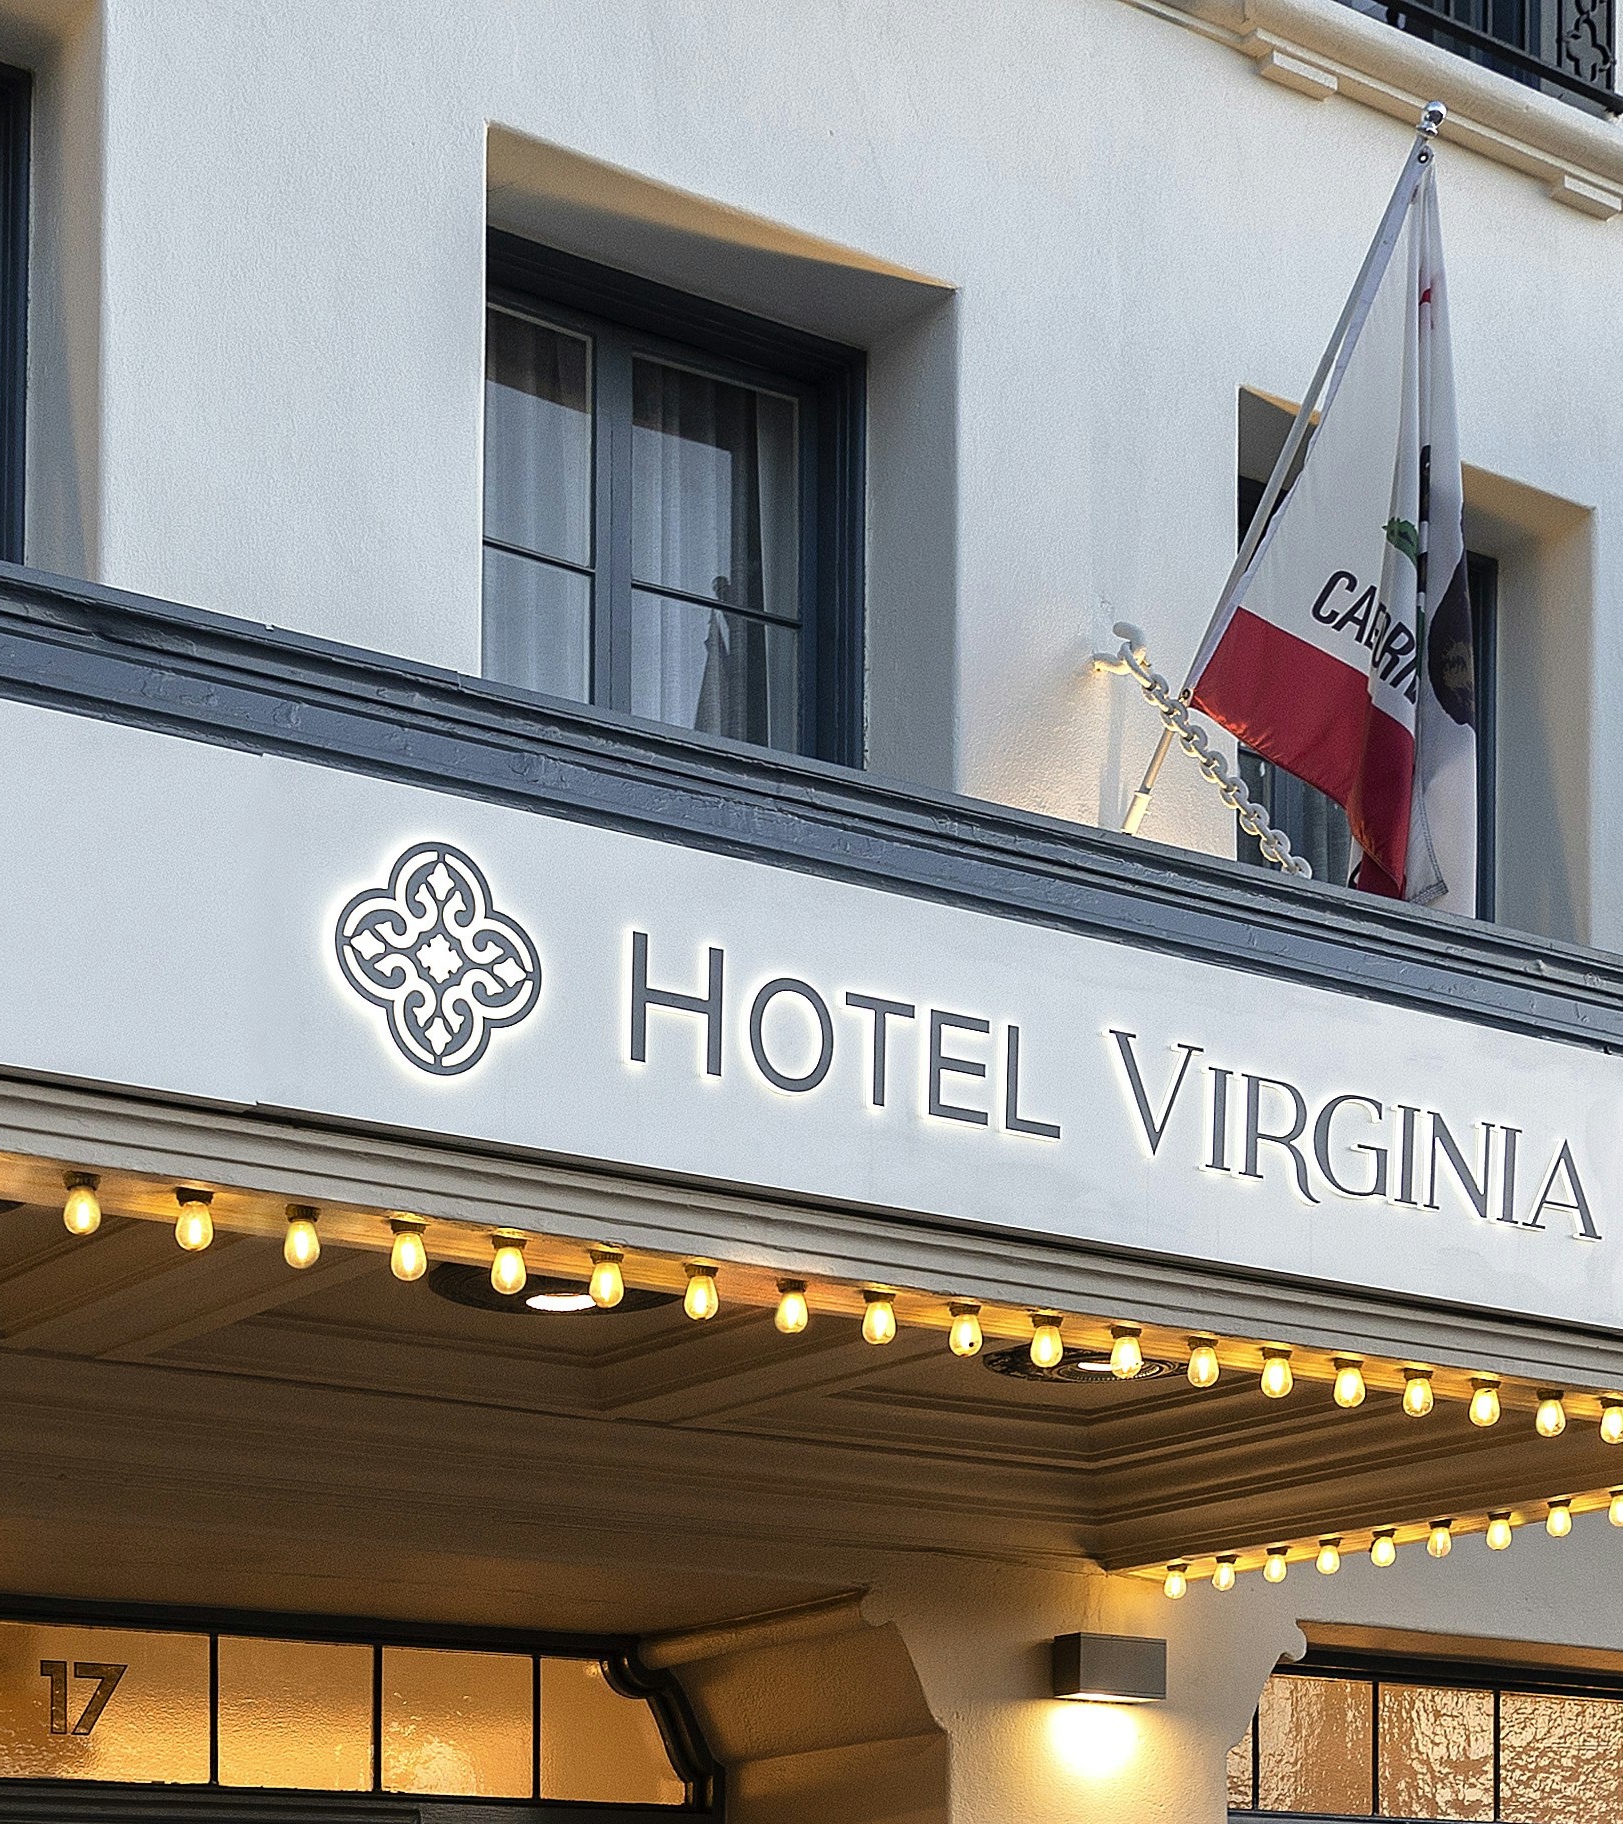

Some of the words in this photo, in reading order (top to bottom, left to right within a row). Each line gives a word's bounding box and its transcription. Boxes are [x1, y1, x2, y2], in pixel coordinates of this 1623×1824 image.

[629, 930, 1062, 1140] HOTEL
[1105, 1028, 1603, 1242] VIRGINIA
[40, 1660, 128, 1735] 17
